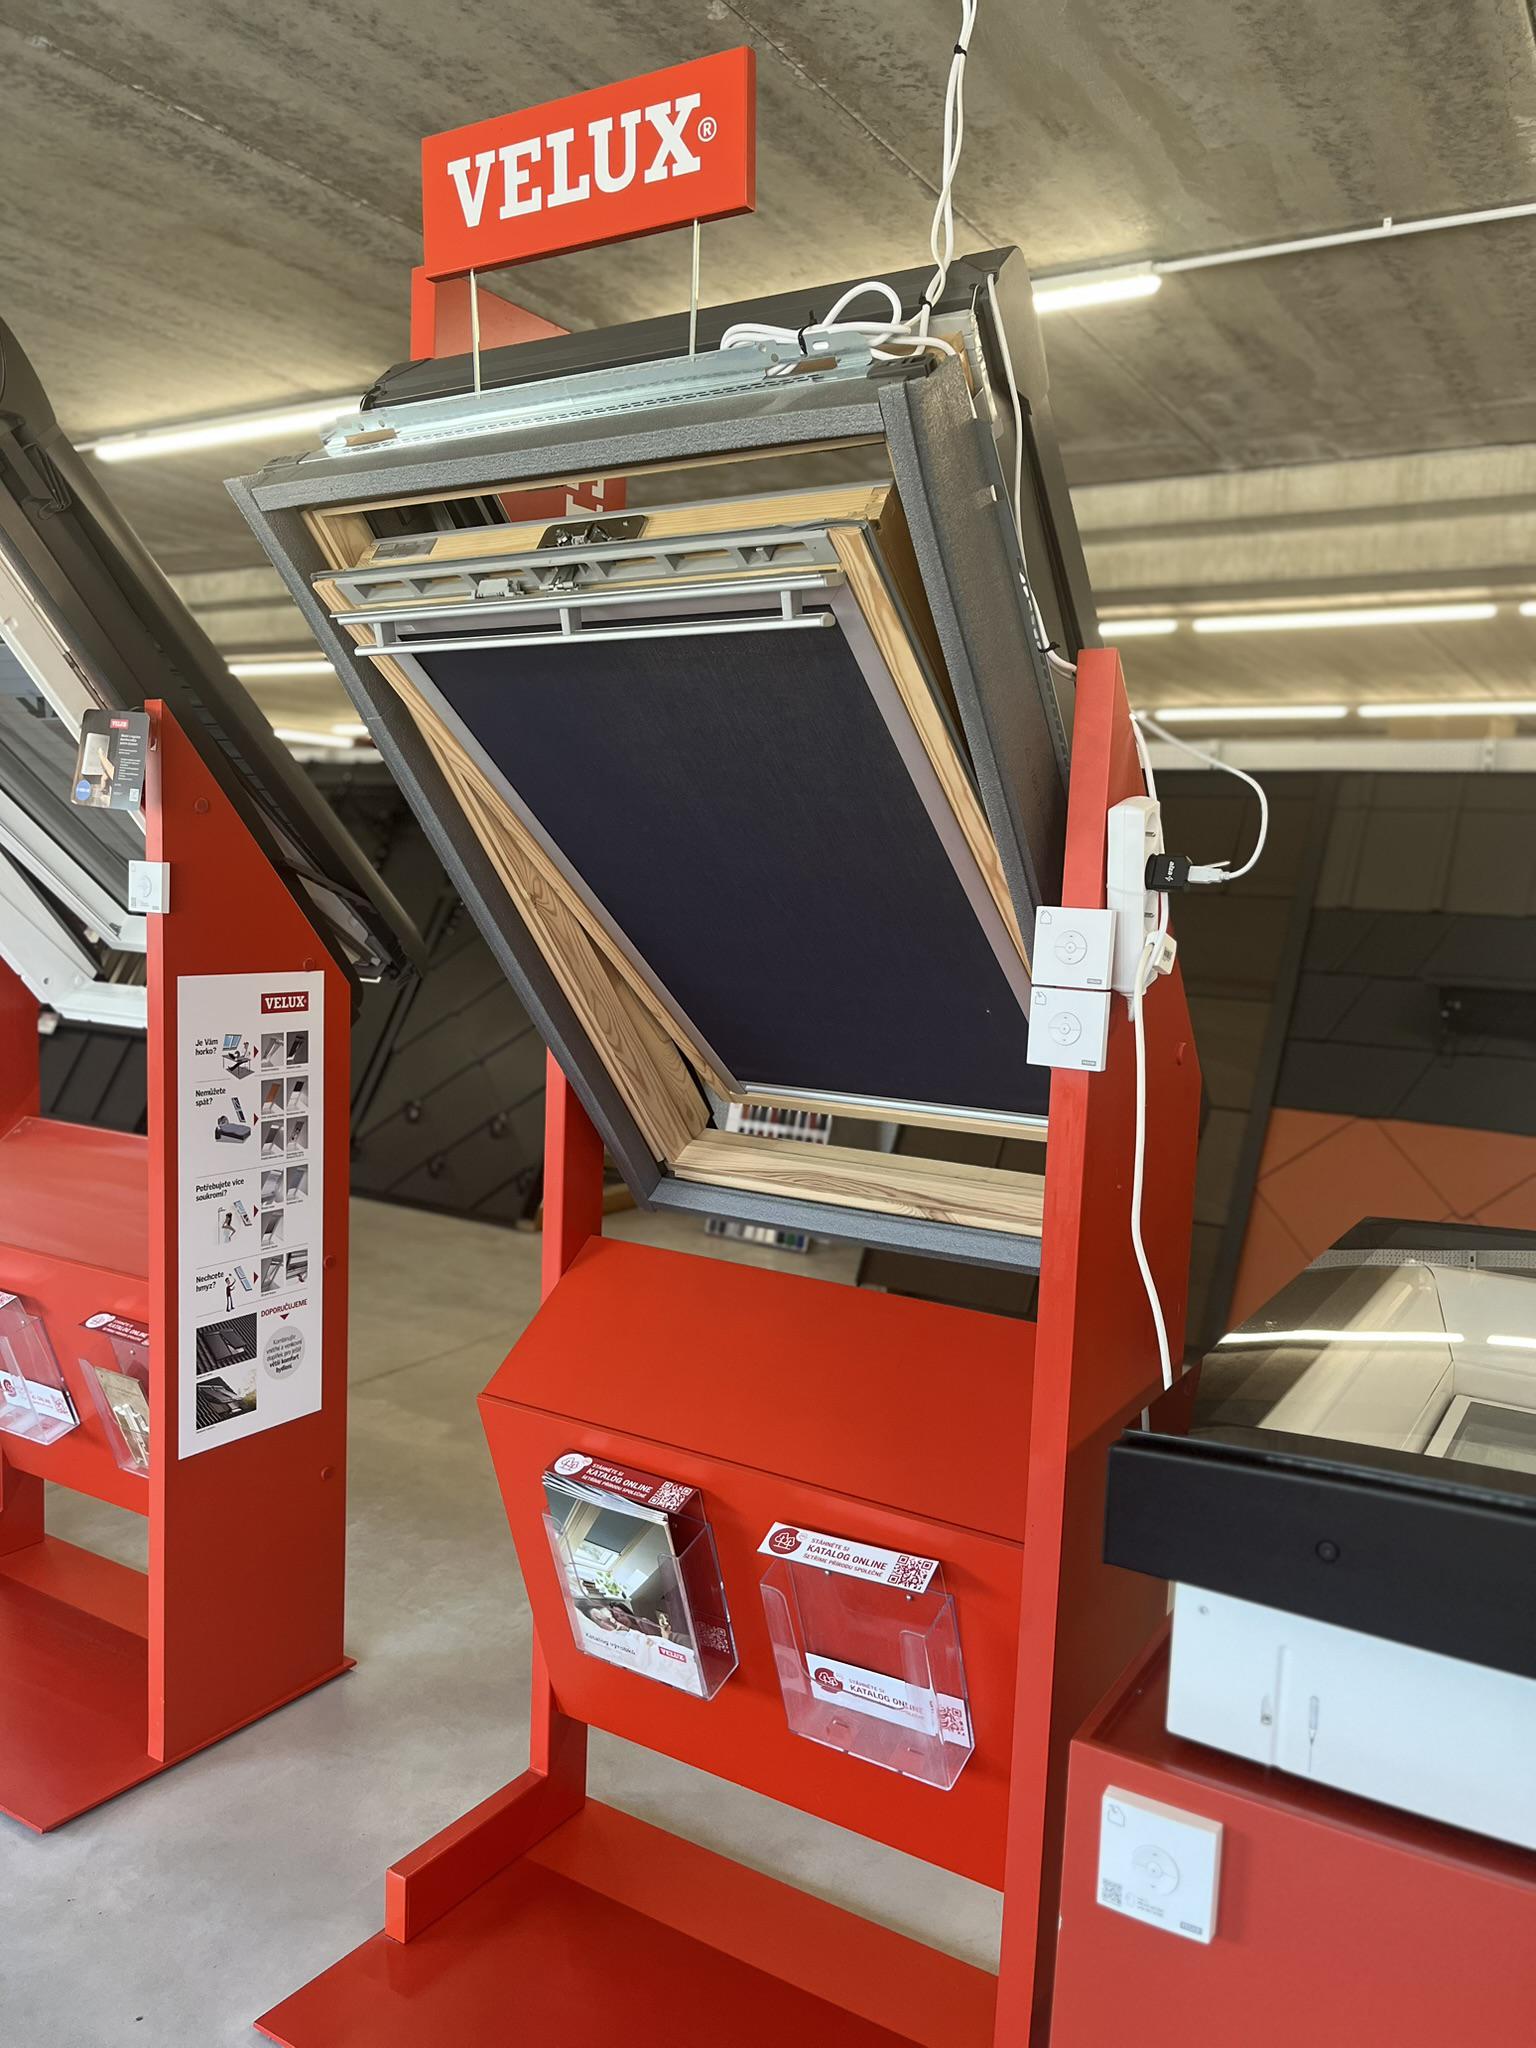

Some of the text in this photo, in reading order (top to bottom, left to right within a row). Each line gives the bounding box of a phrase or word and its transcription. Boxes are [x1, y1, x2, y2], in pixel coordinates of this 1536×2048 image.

[264, 995, 305, 1010] VELUX
[195, 1039, 203, 1047] Je
[195, 1047, 217, 1056] horko?
[195, 1177, 245, 1193] Potřebujete více
[195, 1189, 228, 1202] soukromí?
[195, 1270, 224, 1284] Nechcete
[195, 1281, 217, 1294] hmyz?
[260, 1298, 308, 1318] DOPORUČUJEME
[586, 1468, 654, 1493] KATALOG ONLINE
[807, 1544, 888, 1571] KATALOG ONLINE
[850, 1684, 891, 1702] KATALOG
